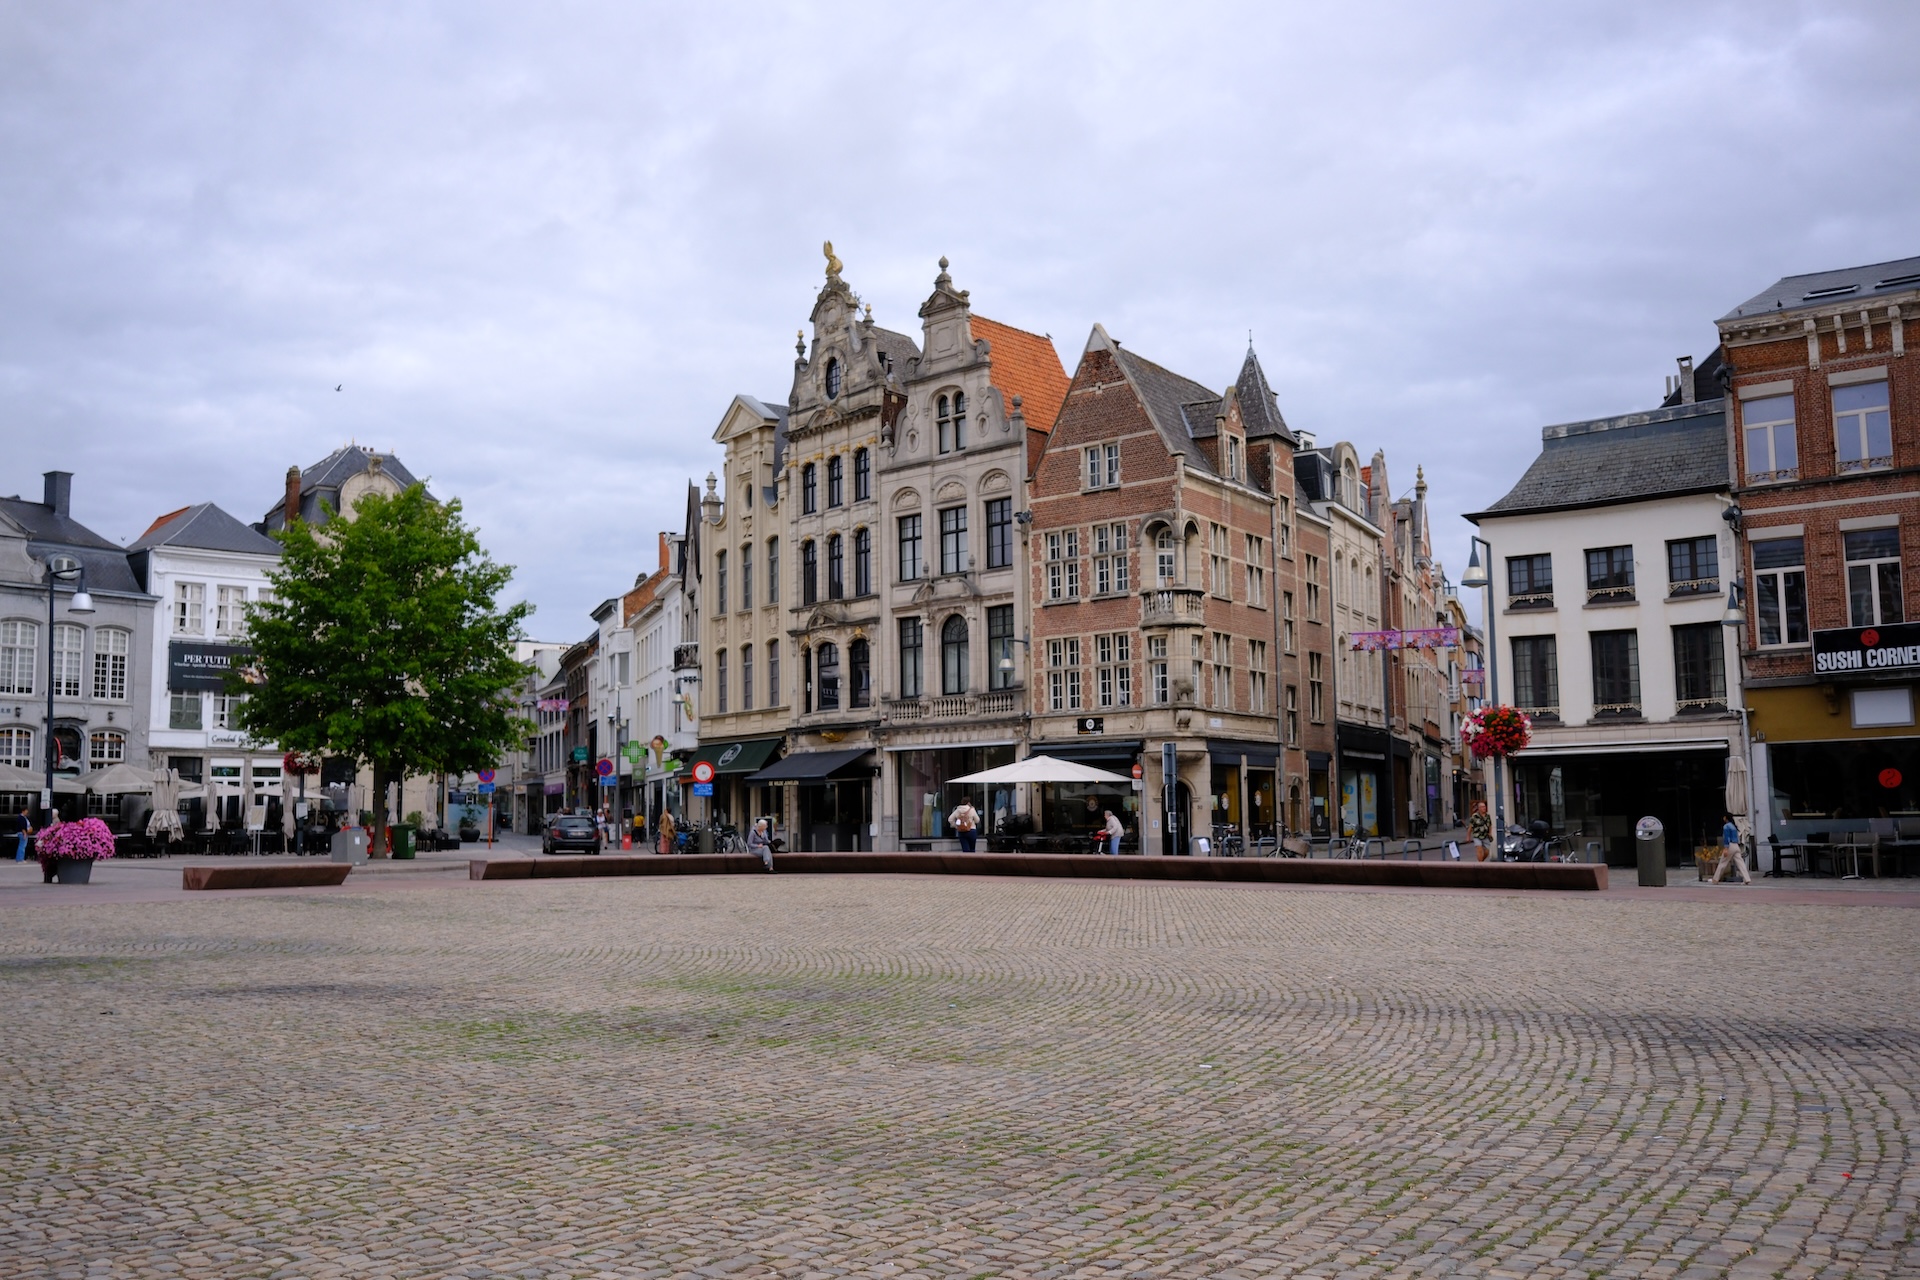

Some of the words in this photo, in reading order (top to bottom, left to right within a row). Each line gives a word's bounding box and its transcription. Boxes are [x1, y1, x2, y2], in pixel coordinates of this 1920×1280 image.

[184, 654, 202, 663] PER
[1817, 650, 1862, 670] SUSHI
[1866, 645, 1920, 667] CORNE
